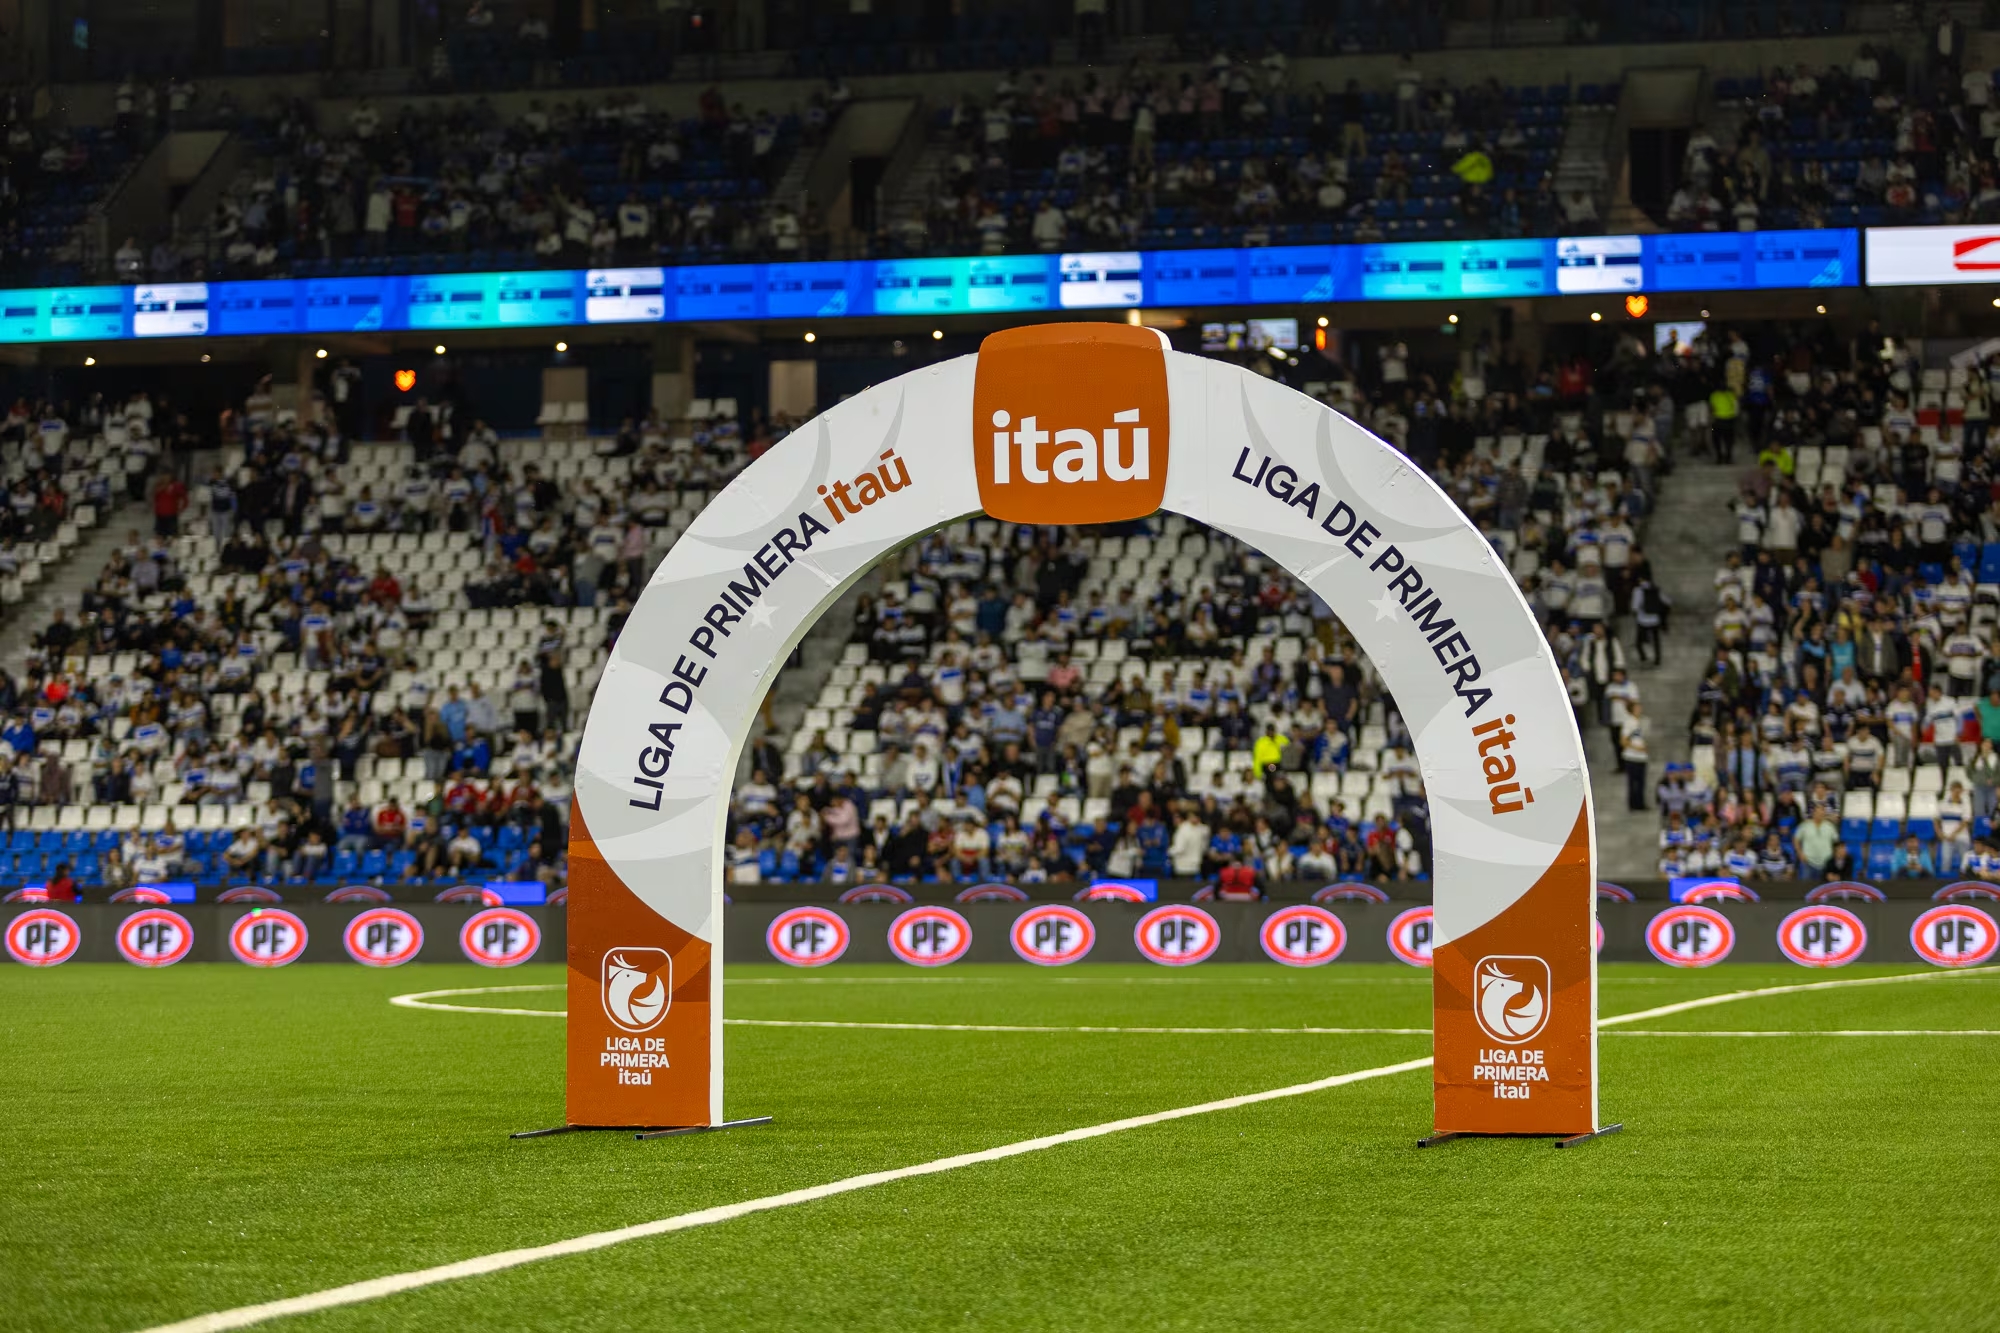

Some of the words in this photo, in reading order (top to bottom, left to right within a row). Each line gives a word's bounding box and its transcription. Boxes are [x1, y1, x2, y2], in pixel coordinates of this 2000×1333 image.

[992, 408, 1150, 485] itaú
[629, 720, 683, 812] LIGA
[658, 654, 709, 715] DE
[688, 512, 830, 659] PRIMERA
[816, 448, 912, 525] itaú
[1231, 446, 1321, 520] LIGA
[1321, 500, 1382, 559] DE
[1369, 544, 1493, 719] PRIMERA
[1471, 713, 1535, 815] itaú
[26, 922, 60, 954] PF
[138, 922, 172, 954] PF
[253, 923, 286, 954] PF
[367, 922, 401, 954] PF
[484, 922, 517, 954] PF
[791, 921, 826, 954] PF
[912, 920, 947, 953] PF
[1036, 919, 1070, 952] PF
[1160, 919, 1196, 952] PF
[1286, 919, 1322, 953] PF
[1412, 922, 1430, 951] P
[1672, 920, 1710, 954] PF
[1803, 920, 1841, 954] PF
[1936, 920, 1976, 954] PF
[600, 1052, 670, 1068] PRIMERA
[606, 1037, 641, 1051] LIGA
[644, 1038, 665, 1052] DE
[1479, 1048, 1518, 1064] LIGA
[1521, 1050, 1544, 1064] DE
[618, 1068, 652, 1085] itaú
[1473, 1065, 1550, 1081] PRIMERA
[1493, 1081, 1530, 1099] itaú
